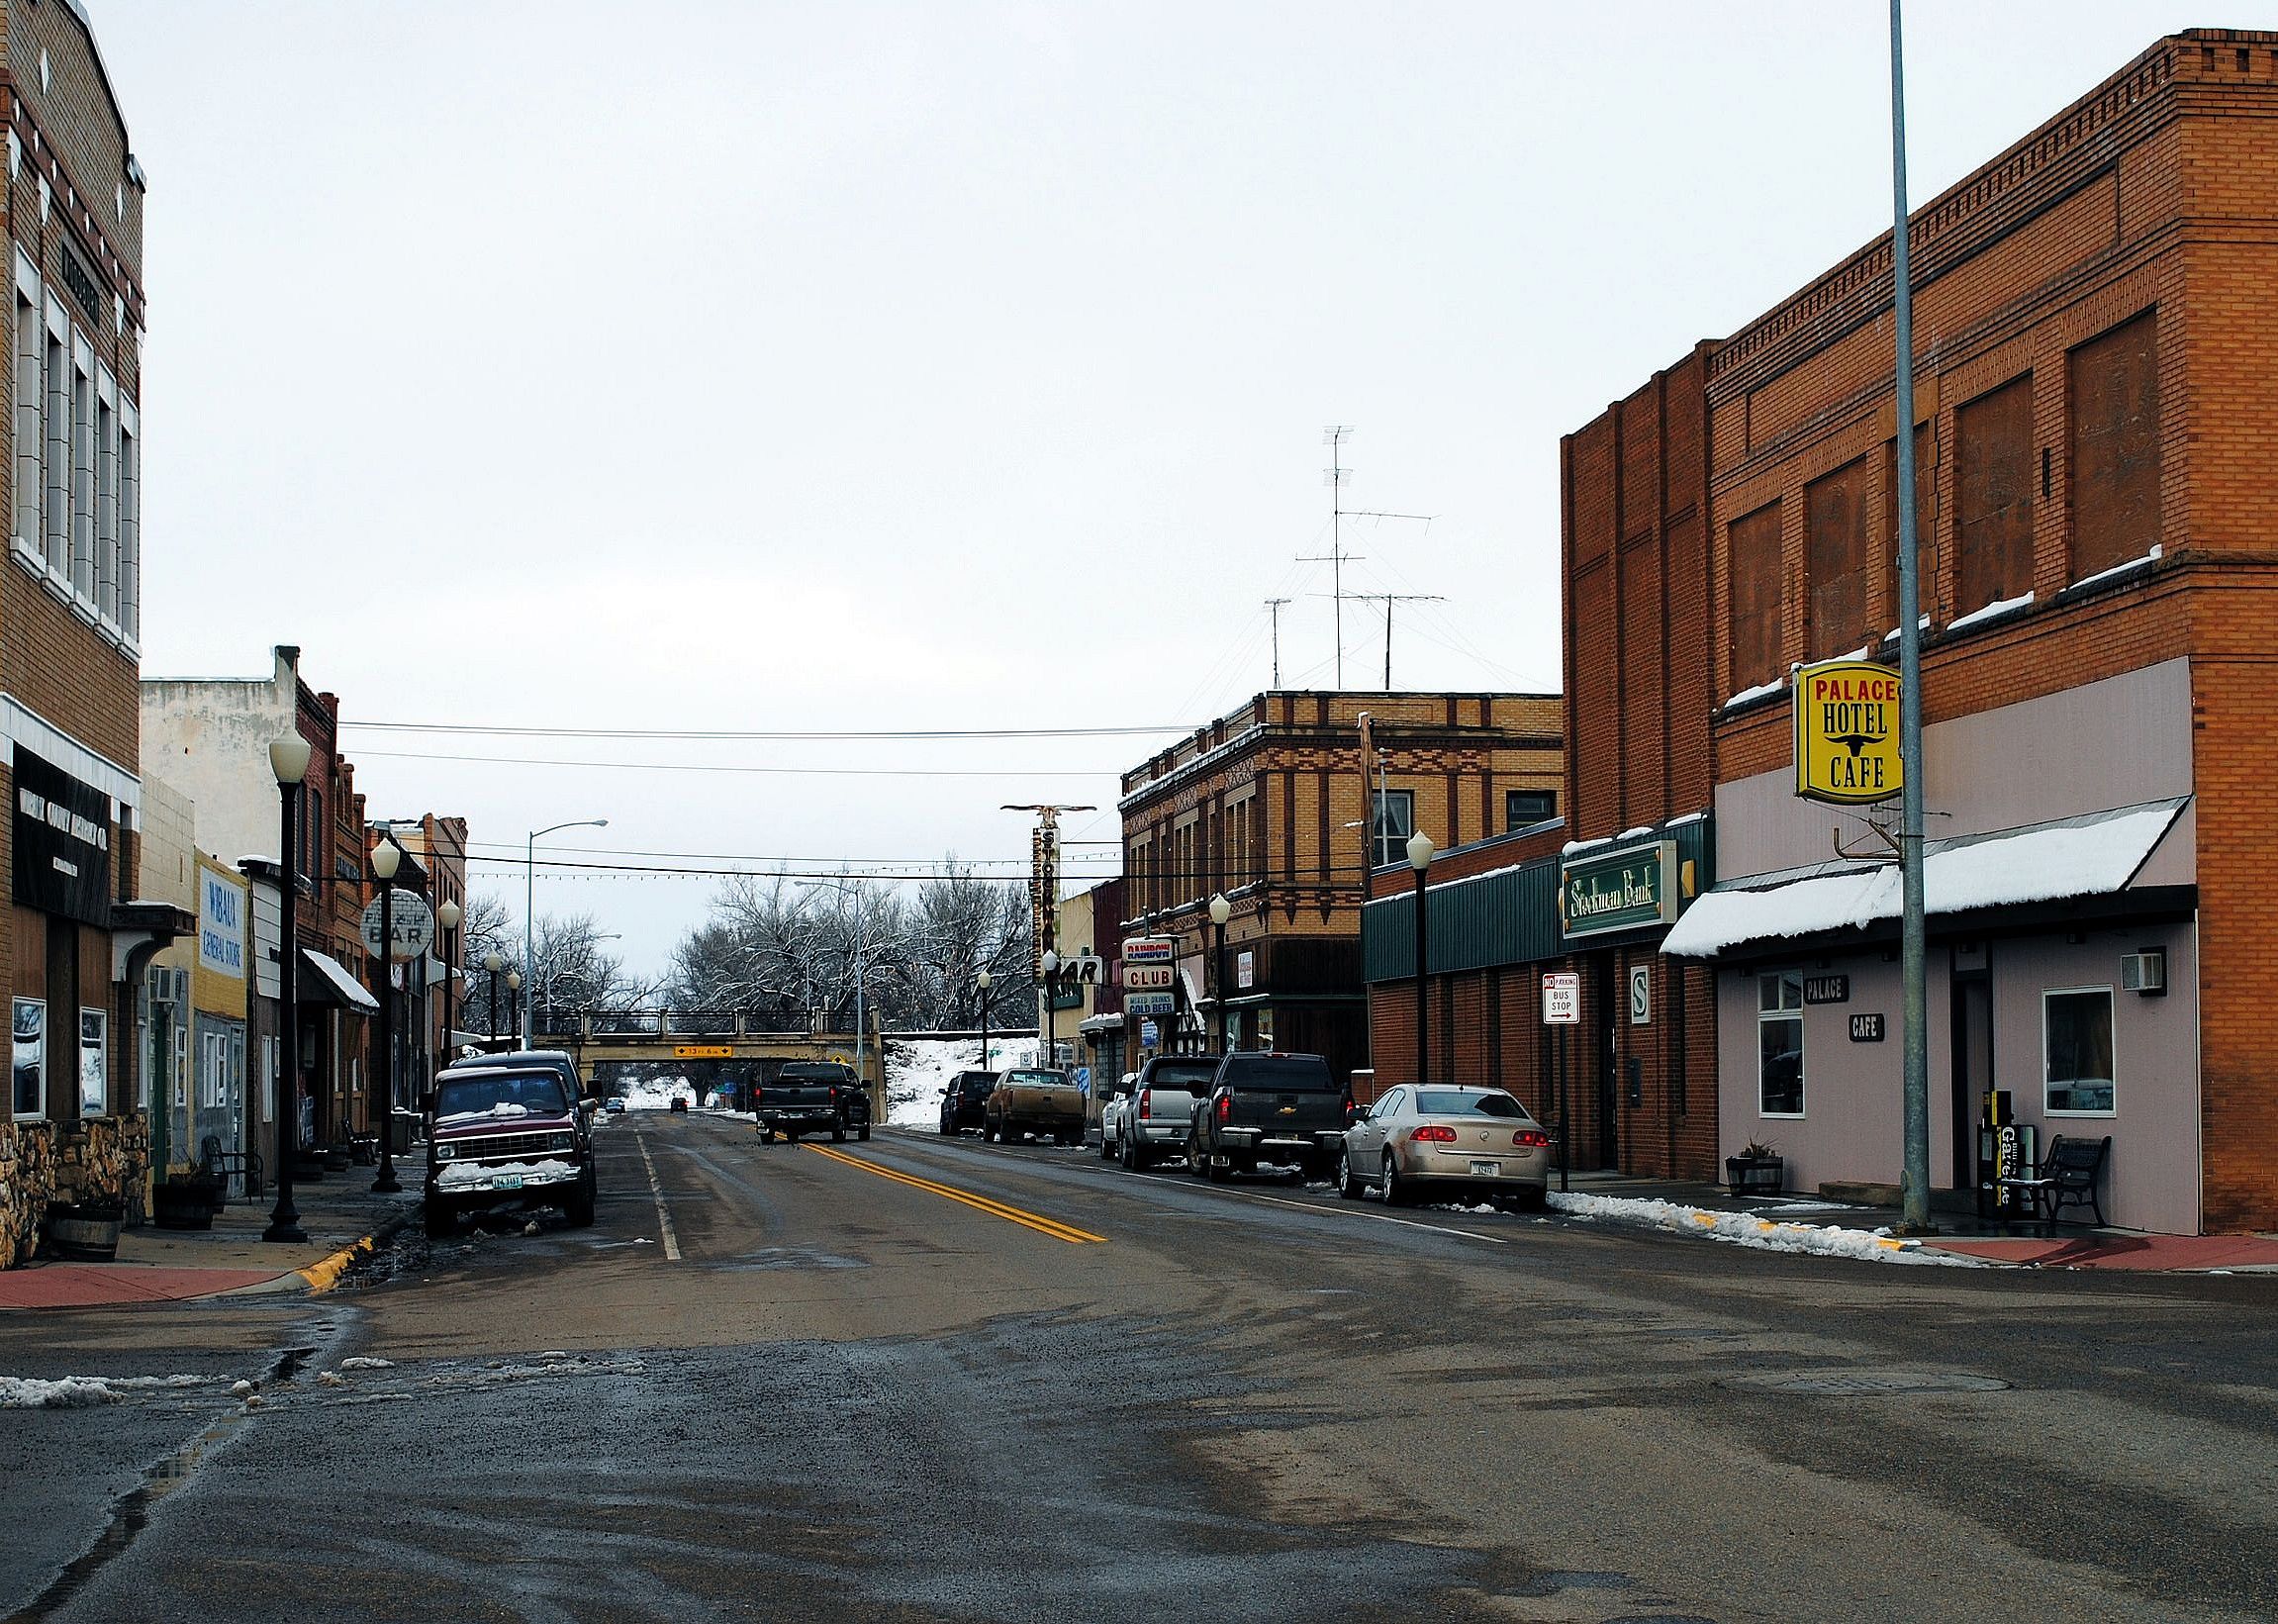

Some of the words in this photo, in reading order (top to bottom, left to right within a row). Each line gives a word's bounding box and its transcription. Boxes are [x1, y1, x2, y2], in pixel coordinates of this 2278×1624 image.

[1816, 680, 1895, 701] PALACE
[1823, 702, 1887, 733] HOTEL
[1831, 757, 1883, 788] CAFE
[1571, 877, 1621, 917] Stockman
[1623, 865, 1654, 908] Bank
[209, 881, 237, 929] WIBAUX
[370, 924, 422, 944] BAR
[1127, 944, 1171, 960] RAINBOW
[1060, 961, 1098, 984] AR
[1130, 971, 1170, 986] CLUB
[1544, 978, 1554, 987] NO
[1633, 972, 1647, 1016] S
[1807, 979, 1842, 1001] PALACE
[1129, 1004, 1150, 1013] COLD
[1153, 1003, 1172, 1012] BEER
[1852, 1016, 1877, 1038] CAFE
[2001, 1126, 2015, 1204] Gazete
